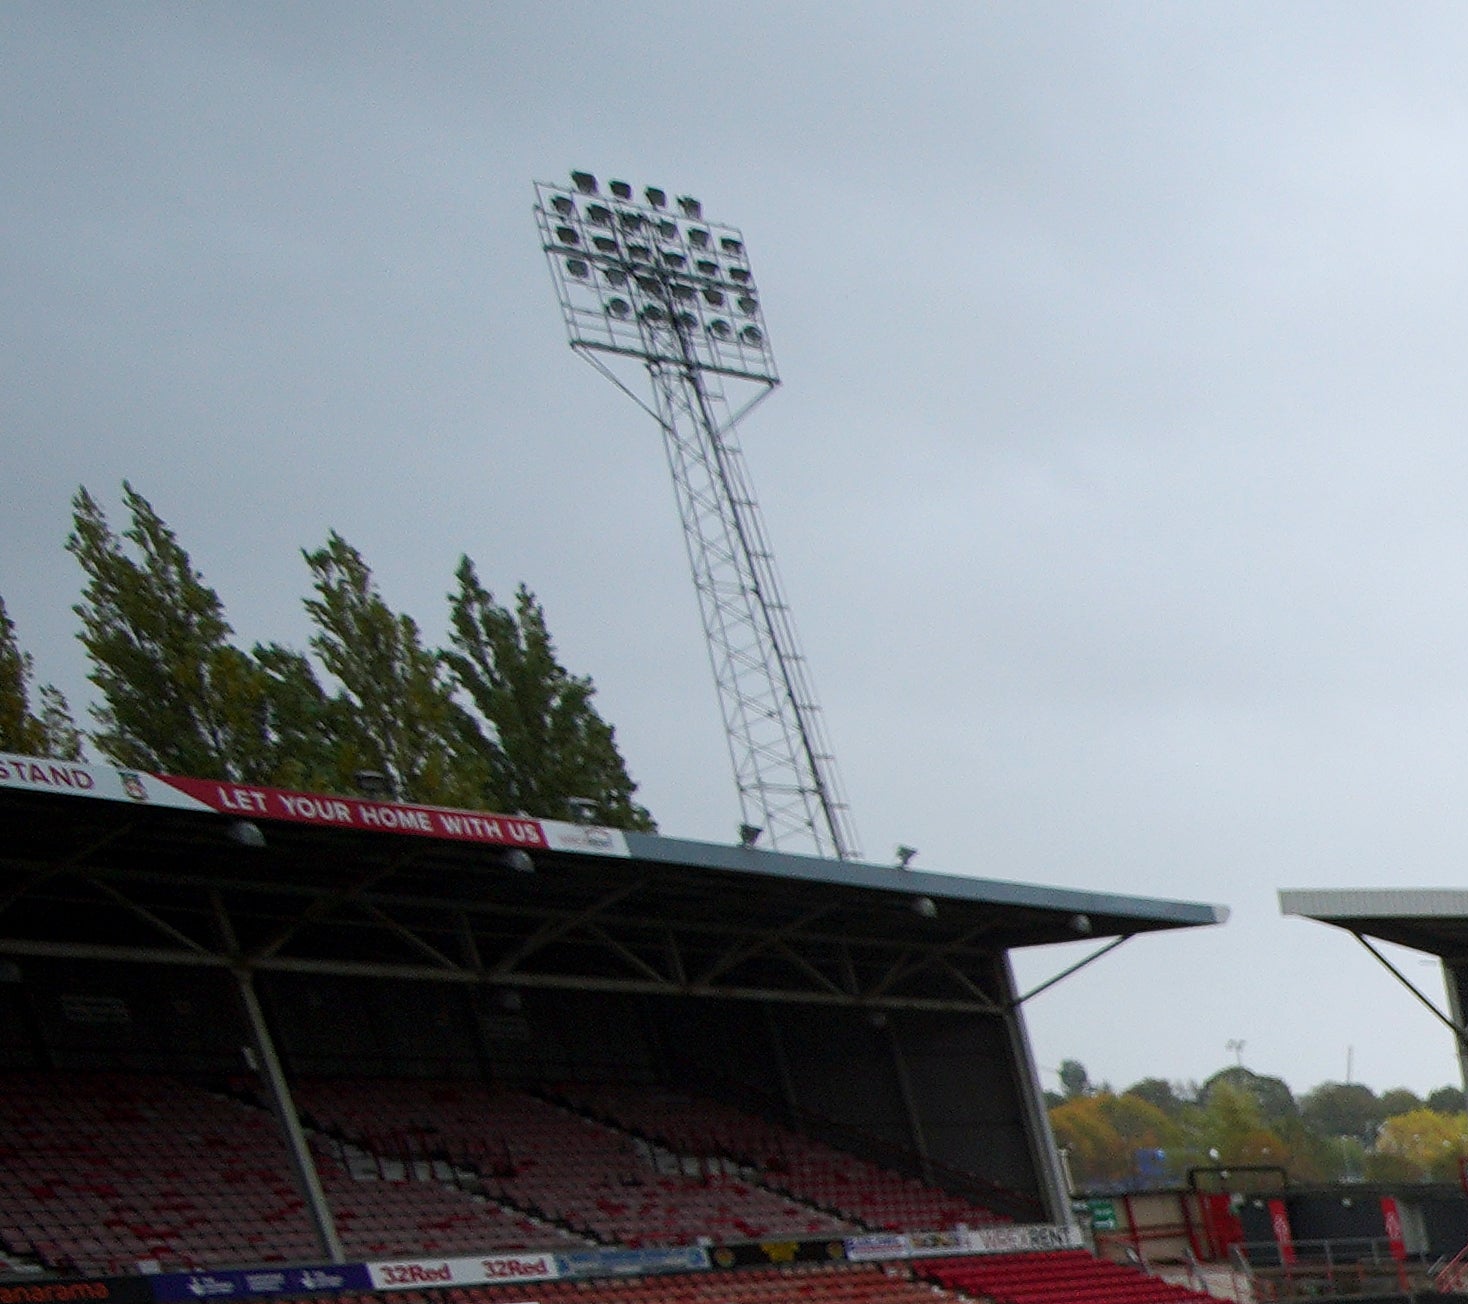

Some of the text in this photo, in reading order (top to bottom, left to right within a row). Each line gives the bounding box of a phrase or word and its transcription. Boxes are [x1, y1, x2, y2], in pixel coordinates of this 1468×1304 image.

[0, 760, 96, 790] STAND
[217, 786, 269, 813] LET
[278, 795, 354, 823] YOUR
[357, 803, 434, 833] HOME
[439, 813, 505, 841] WITH
[509, 821, 542, 844] US
[380, 1263, 453, 1285] 32Red
[482, 1257, 548, 1279] 32Red
